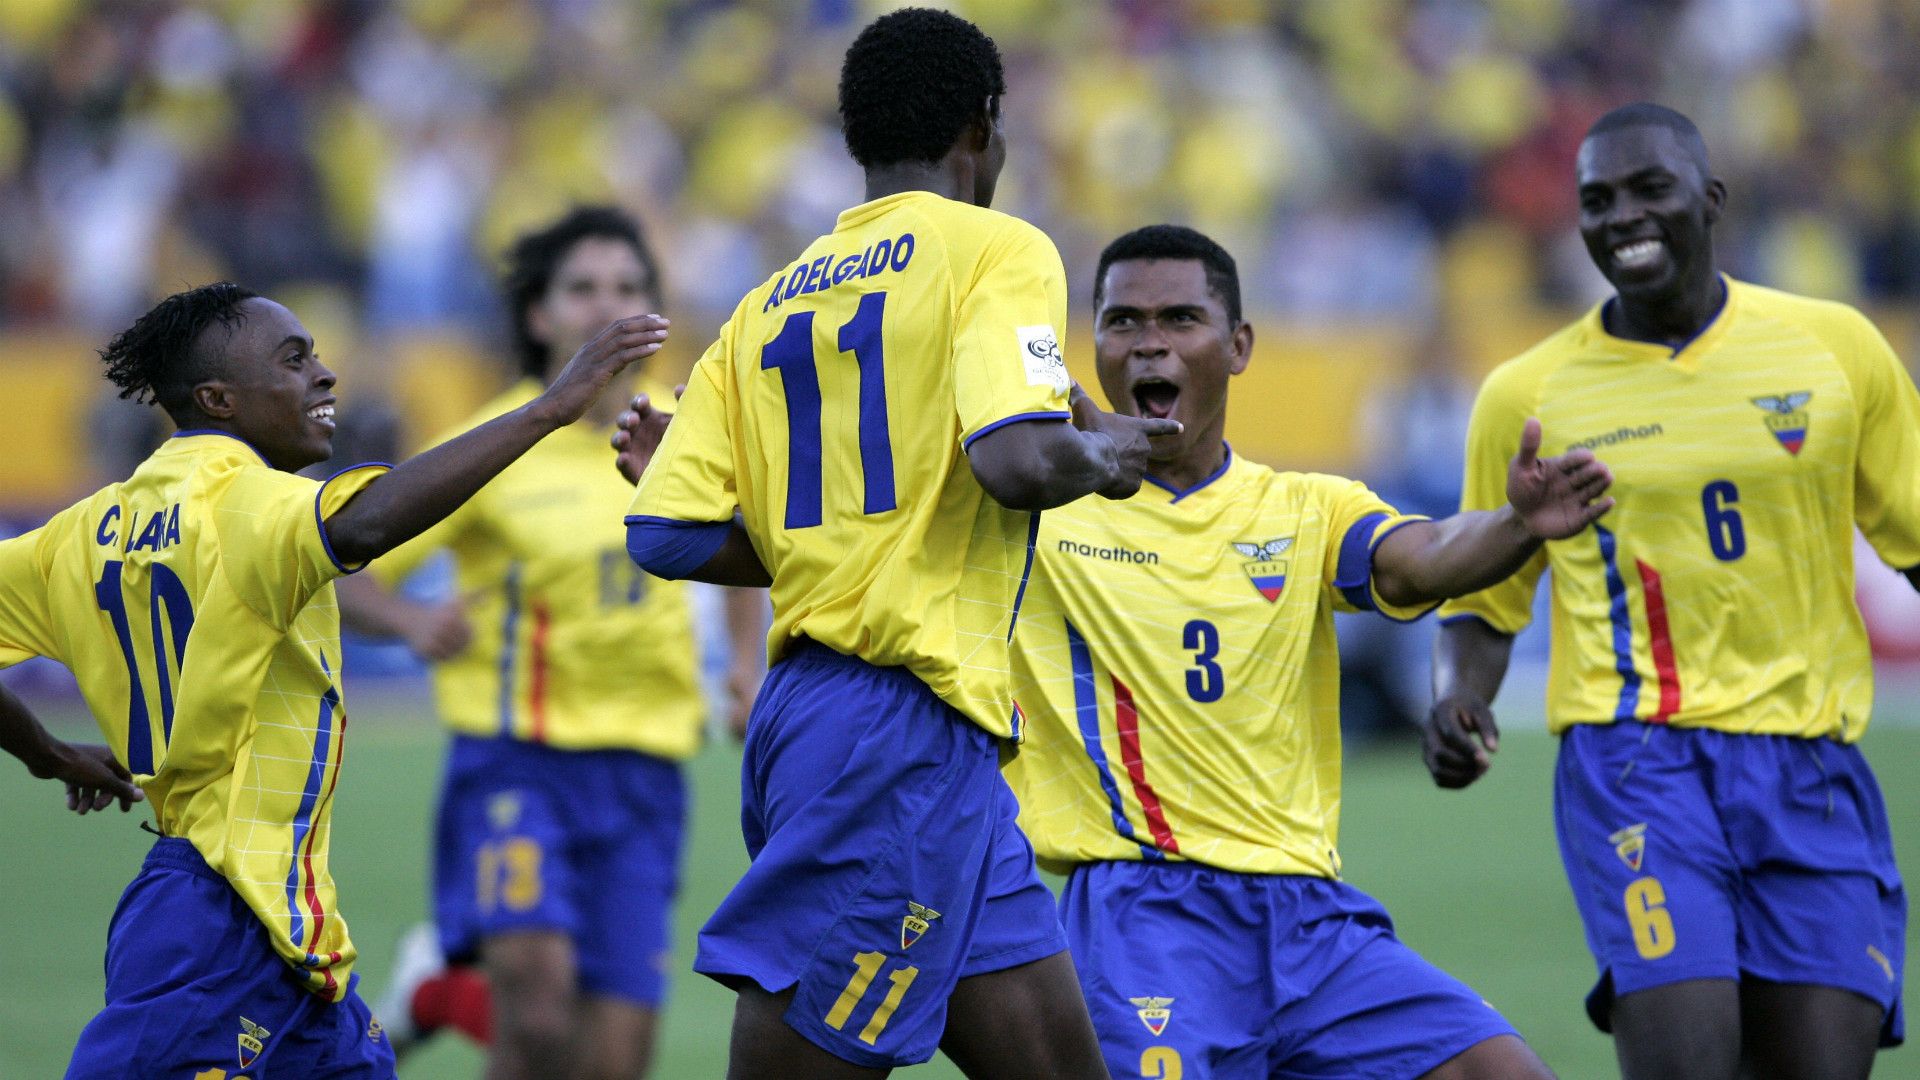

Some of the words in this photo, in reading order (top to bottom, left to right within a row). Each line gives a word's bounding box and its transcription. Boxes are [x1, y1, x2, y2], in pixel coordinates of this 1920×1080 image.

[761, 291, 897, 529] 11
[1058, 540, 1159, 564] marathon
[1702, 479, 1747, 563] 6
[95, 560, 195, 775] 10
[1183, 619, 1224, 703] 3
[907, 919, 924, 931] FEF
[1624, 876, 1676, 960] 6
[824, 951, 919, 1046] 11
